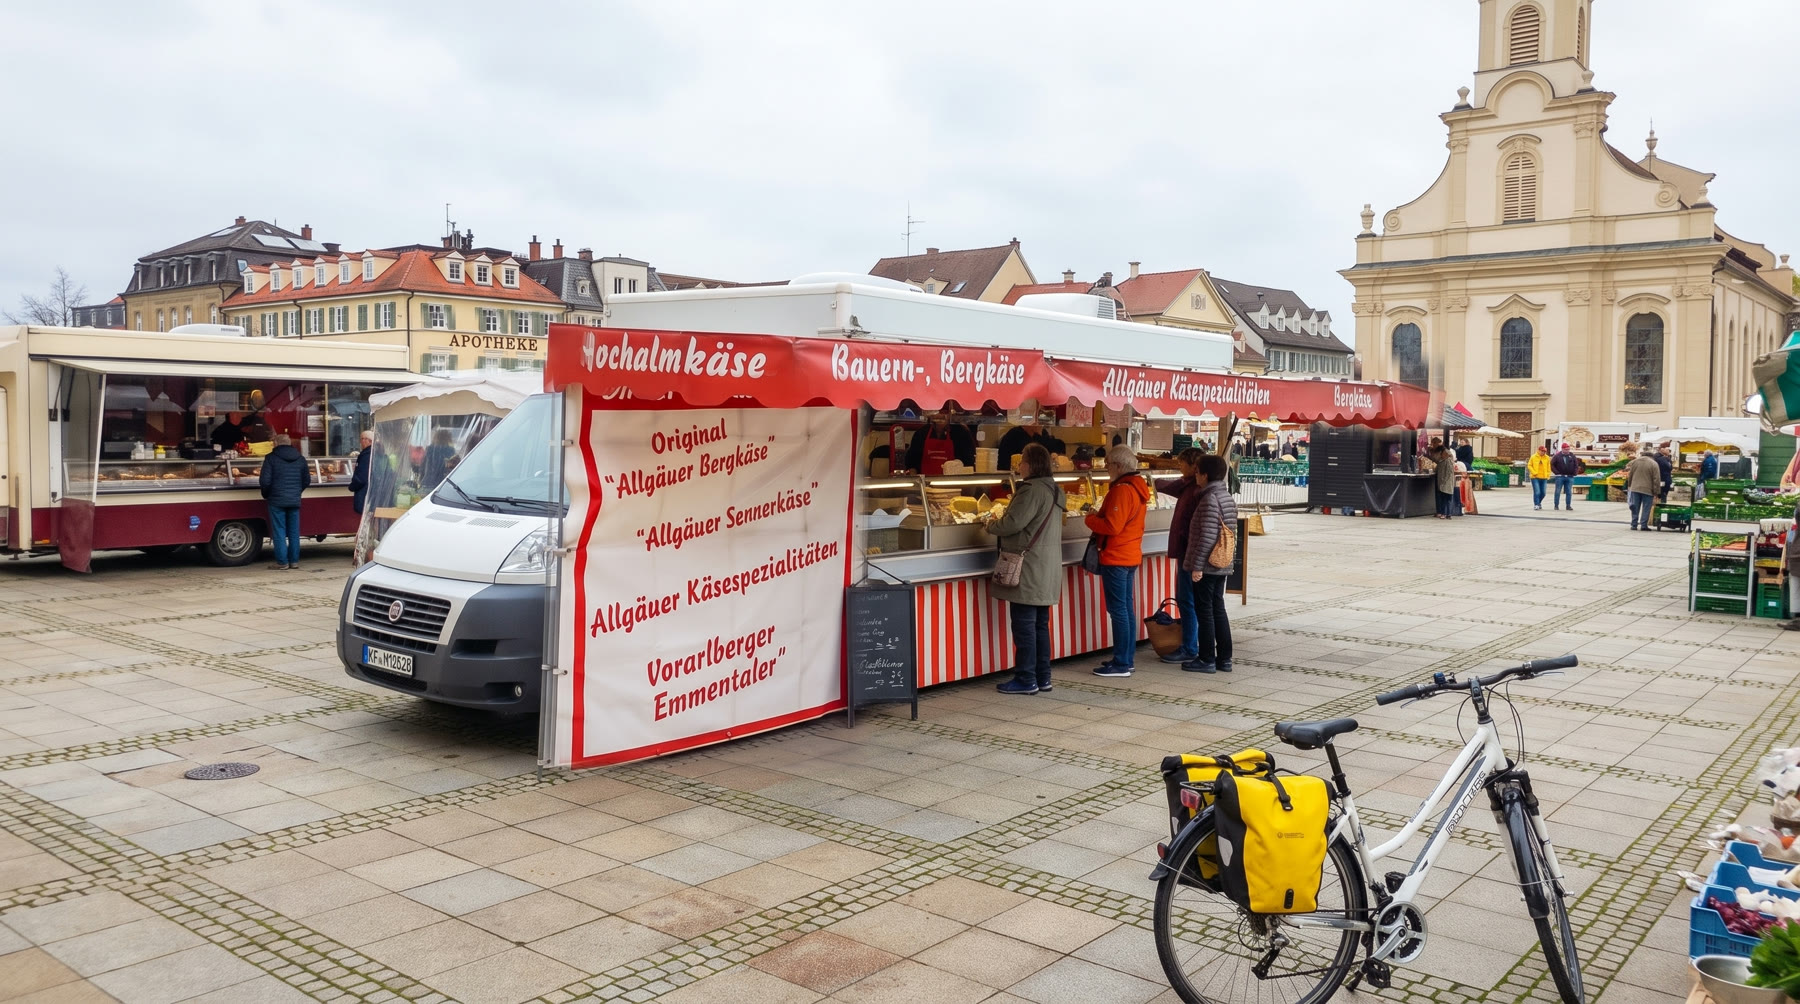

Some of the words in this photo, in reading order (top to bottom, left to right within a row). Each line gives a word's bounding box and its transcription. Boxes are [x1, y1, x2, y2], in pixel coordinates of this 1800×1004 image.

[449, 333, 538, 351] APOTHEKE
[581, 331, 767, 378] Hochalmkäse
[831, 343, 931, 386] Bauern-,
[940, 349, 1025, 392] Bergkäse
[1103, 367, 1167, 404] Allgäuer
[1169, 374, 1270, 408] Käsespezialitäten
[1333, 385, 1373, 412] Bergkäse
[651, 417, 728, 455] Original
[590, 592, 680, 638] Allgäuer
[687, 541, 838, 606] Käsespezialitäten
[368, 648, 378, 664] KF
[647, 625, 775, 687] Vorarlberger
